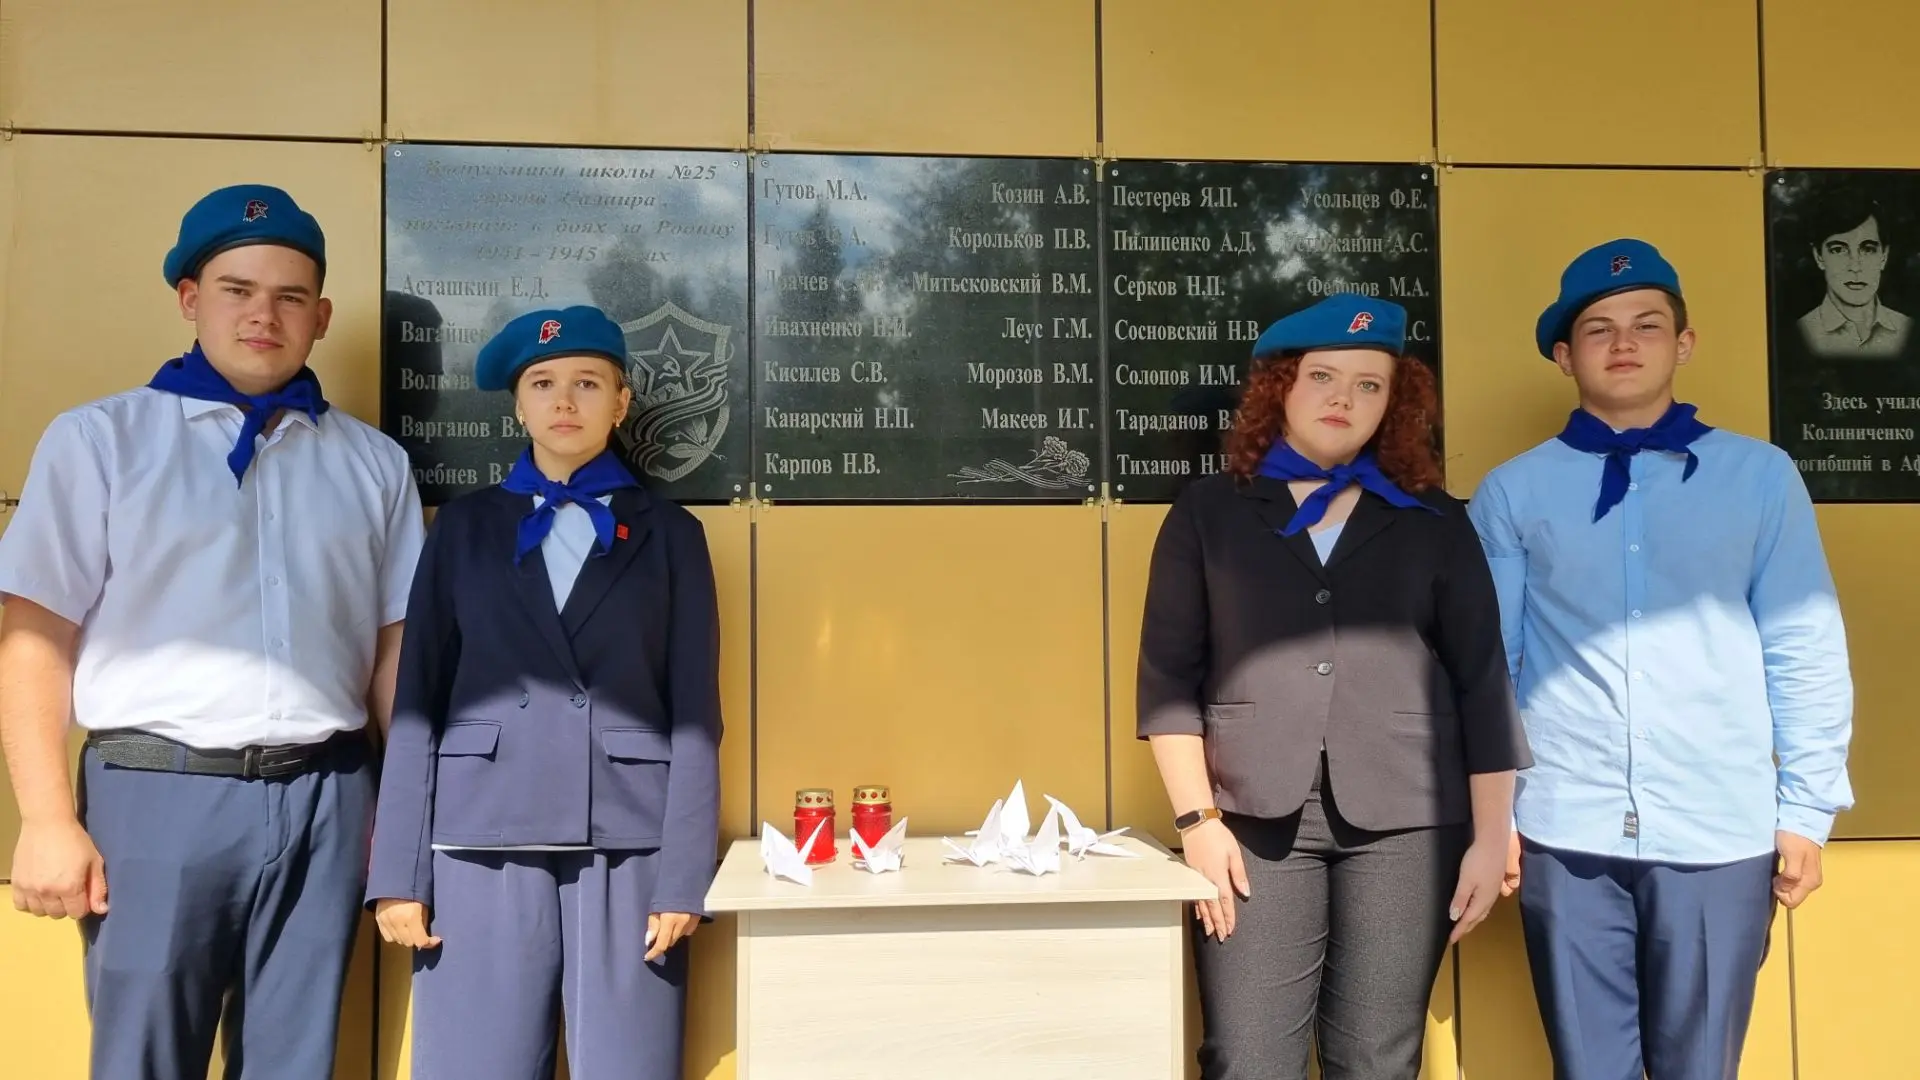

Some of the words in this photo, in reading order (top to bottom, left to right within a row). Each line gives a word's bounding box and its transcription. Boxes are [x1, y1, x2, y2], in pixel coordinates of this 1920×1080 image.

[578, 166, 655, 180] школы
[666, 165, 717, 180] №25
[826, 179, 868, 201] М.А.
[991, 183, 1044, 204] Козин
[1054, 184, 1090, 205] А.В.
[1112, 186, 1190, 212] Пестерев
[1200, 188, 1237, 208] Я.П.
[1301, 189, 1380, 210] Усольцев
[1389, 189, 1427, 210] Ф.Е.
[948, 228, 1043, 253] Корольков
[1053, 229, 1090, 250] П.В.
[1113, 230, 1210, 252] Пилипенко
[1219, 231, 1256, 256] А.Д.
[1389, 232, 1428, 253] А.С.
[548, 247, 598, 262] 1945
[402, 274, 500, 297] Асташкин
[511, 276, 550, 300] Е.Д.
[911, 271, 1041, 294] Митьсковский
[1051, 273, 1091, 295] В.М.
[1113, 275, 1177, 301] Серков
[1186, 275, 1225, 296] Н.П.
[1389, 276, 1430, 297] М.А.
[763, 315, 863, 337] Ивахненко
[872, 316, 912, 338] Н.И.
[1001, 317, 1043, 344] Леус
[1052, 318, 1092, 339] Г.М.
[1114, 319, 1217, 341] Сосновский
[401, 367, 470, 391] Волков
[763, 361, 841, 383] Кисилев
[850, 361, 888, 383] С.В.
[967, 362, 1043, 389] Морозов
[1053, 363, 1093, 384] В.М.
[1115, 365, 1190, 385] Солопов
[1199, 365, 1241, 386] И.М.
[1822, 392, 1868, 410] Здесь
[401, 415, 490, 443] Варганов
[764, 407, 864, 434] Канарский
[874, 408, 915, 429] Н.П.
[981, 408, 1048, 429] Макеев
[1057, 408, 1095, 429] И.Г.
[1116, 410, 1208, 436] Тараданов
[1802, 423, 1915, 441] Колиниченко
[410, 462, 478, 485] ребнев
[764, 453, 832, 480] Карпов
[842, 453, 881, 474] Н.В.
[1117, 455, 1191, 475] Тиханов
[1794, 454, 1873, 472] огибший
[1881, 460, 1892, 471] в
